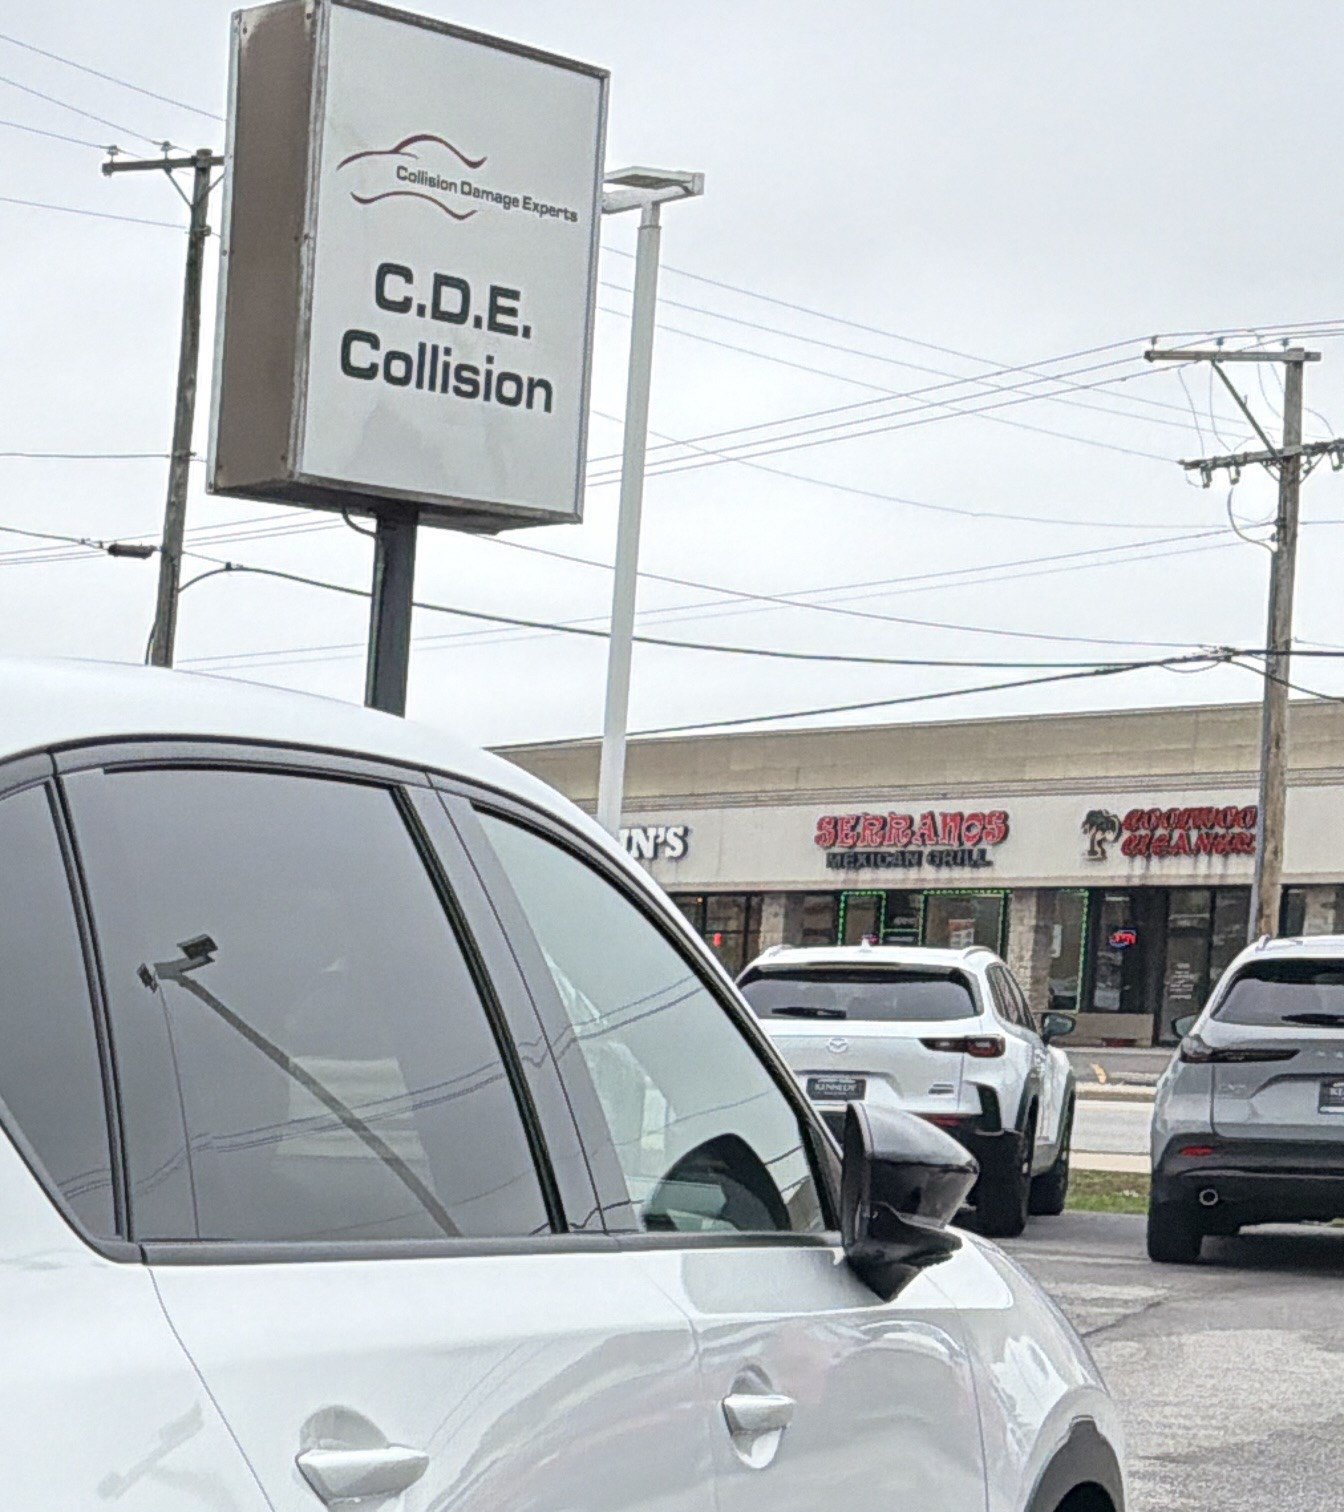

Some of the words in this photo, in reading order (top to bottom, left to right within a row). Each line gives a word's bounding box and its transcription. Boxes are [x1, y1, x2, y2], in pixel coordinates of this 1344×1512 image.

[396, 164, 458, 193] Collision
[460, 181, 519, 210] Damage
[522, 195, 578, 222] Experts
[374, 261, 532, 340] C.D.E.
[340, 328, 554, 413] Collision
[814, 811, 1009, 848] SERRANOS
[825, 850, 924, 870] MEXICAN
[926, 848, 994, 868] GRILL
